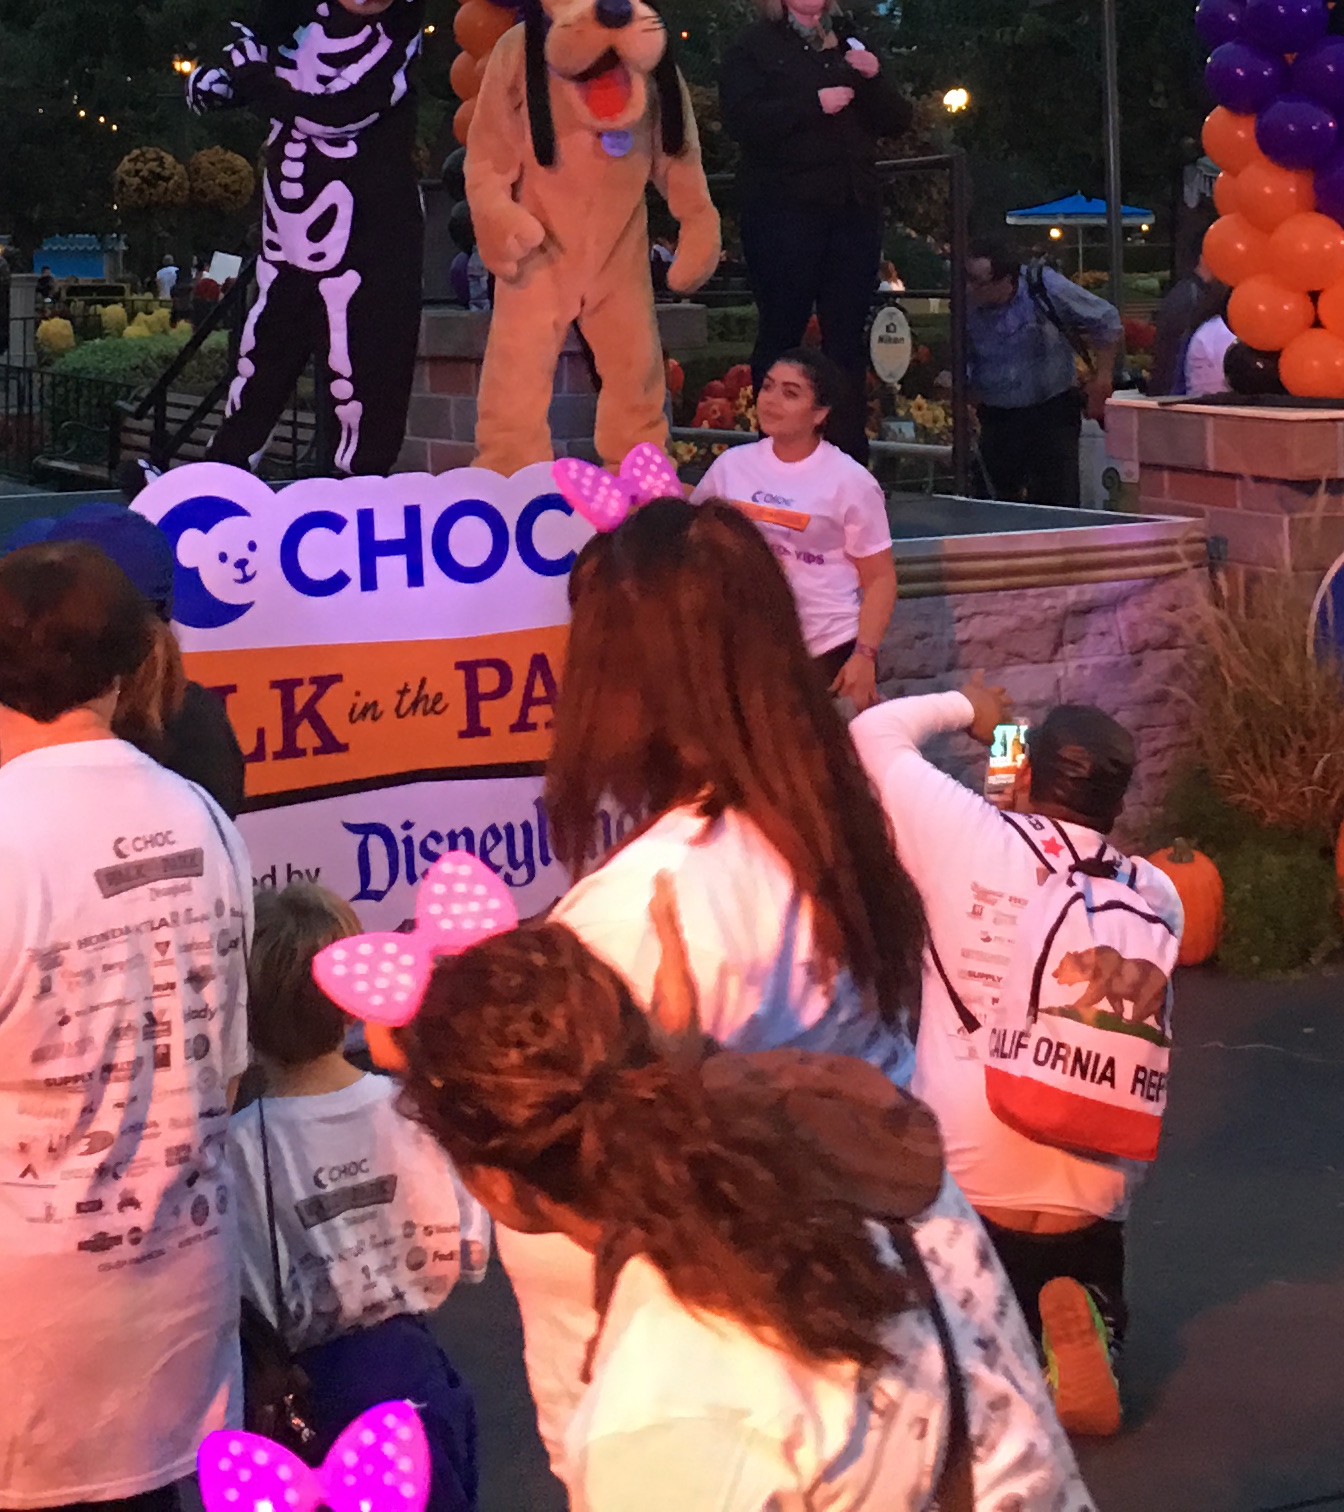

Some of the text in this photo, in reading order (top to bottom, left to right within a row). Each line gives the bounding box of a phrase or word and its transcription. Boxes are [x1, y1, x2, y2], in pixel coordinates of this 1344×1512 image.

[279, 492, 580, 598] CHOC
[218, 651, 560, 764] LK in the PA
[131, 830, 176, 852] CHOC
